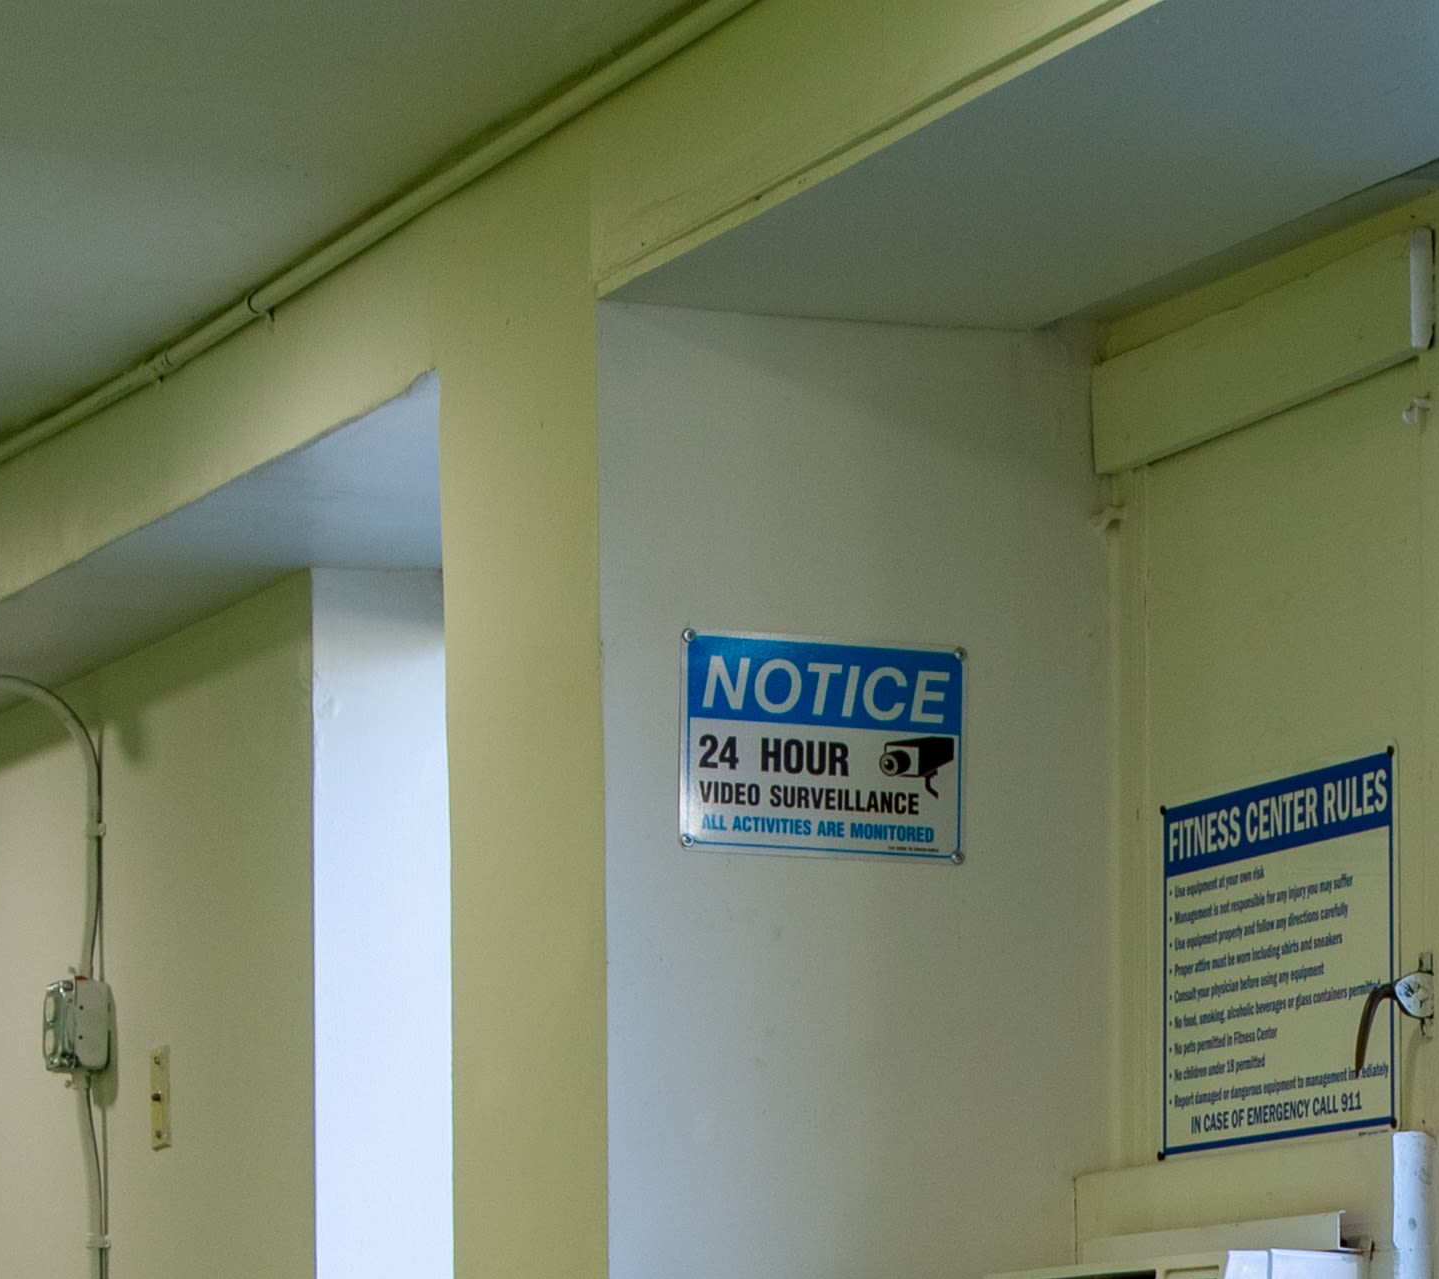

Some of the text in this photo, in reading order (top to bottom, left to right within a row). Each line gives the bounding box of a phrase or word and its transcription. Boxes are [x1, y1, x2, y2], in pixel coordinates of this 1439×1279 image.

[702, 655, 950, 723] NOTICE
[699, 734, 849, 777] 24 HOUR
[699, 781, 919, 815] VIDEO SURVEILLANCE
[1169, 767, 1387, 862] FITNESS CENTER RULES
[702, 813, 934, 843] ALL ACTIVITIES ARE MONITORED
[1174, 865, 1264, 898] Use equipment at your own risk
[1174, 871, 1352, 927] Management is not responsible for any injury you may suffer
[1174, 901, 1348, 951] Use equipment properly and follow any directions carefully
[1174, 930, 1342, 979] Proper attire must be worn including shirts and sneakers
[1174, 962, 1323, 1003] Consult your physician before using any equipment
[1174, 1017, 1181, 1029] No
[1183, 1013, 1197, 1029] food,
[1199, 1008, 1225, 1027] smoking,
[1227, 1002, 1254, 1019] alcoholic
[1255, 997, 1286, 1017] beverages
[1287, 998, 1294, 1008] or
[1295, 991, 1311, 1009] glass
[1313, 985, 1347, 1003] containers
[1174, 1025, 1277, 1057] No pets permitted in Fitness Center
[1174, 1053, 1264, 1082] No children under 18 permitted
[1174, 1061, 1388, 1110] Report damaged or dangerous equipment to management imediately
[1191, 1089, 1362, 1135] IN CASE OF EMERGENCY CALL 911
